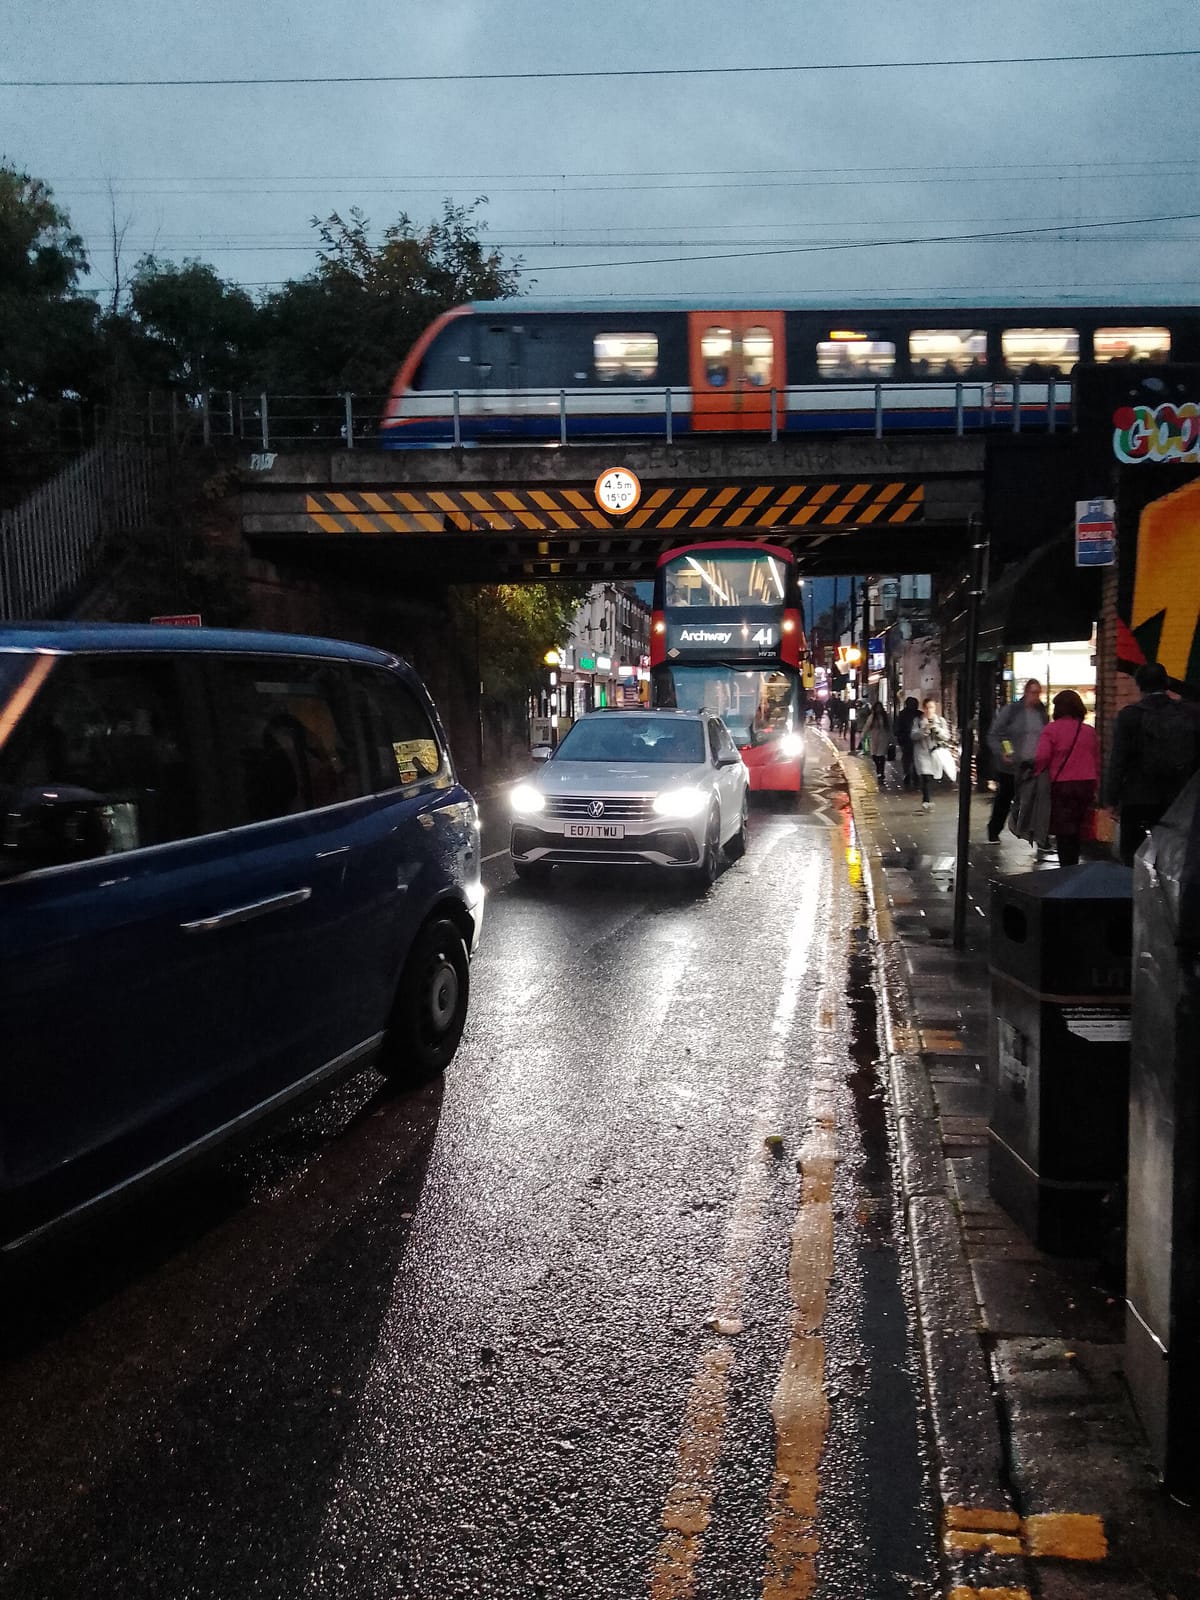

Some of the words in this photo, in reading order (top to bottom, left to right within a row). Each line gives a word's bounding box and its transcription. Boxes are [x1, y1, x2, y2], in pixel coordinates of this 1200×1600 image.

[680, 630, 731, 643] Archway
[752, 628, 772, 645] 41
[596, 826, 617, 837] TWU
